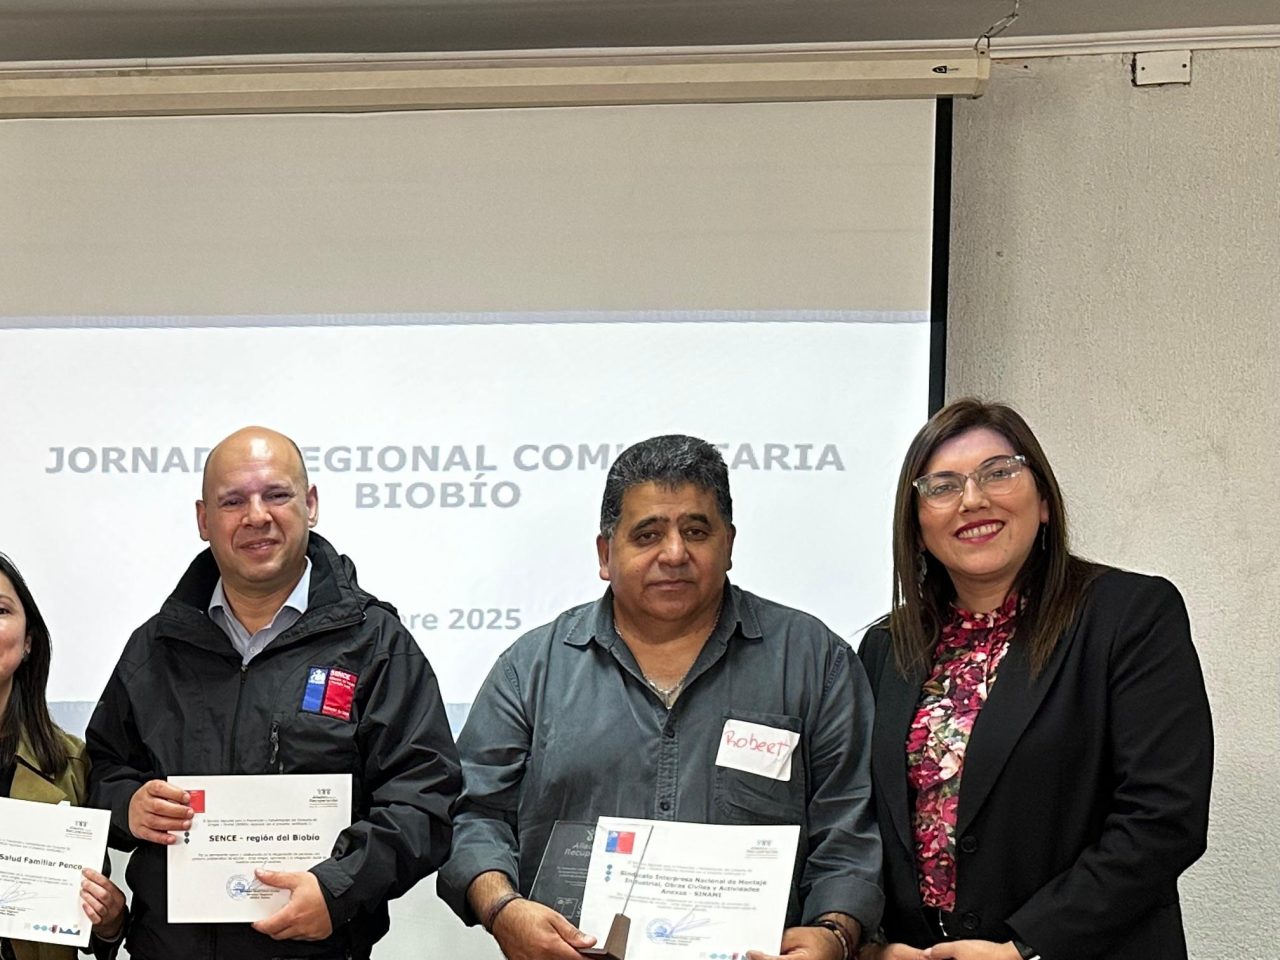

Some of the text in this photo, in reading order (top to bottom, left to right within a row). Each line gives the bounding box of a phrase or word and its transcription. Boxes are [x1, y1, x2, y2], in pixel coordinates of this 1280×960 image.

[355, 473, 521, 509] BIOBÍO
[448, 608, 522, 631] 2025
[209, 834, 237, 843] SENCE
[246, 834, 274, 843] región
[276, 833, 290, 842] del
[0, 853, 22, 863] Salud
[24, 857, 57, 868] Familiar
[59, 861, 83, 871] Penco
